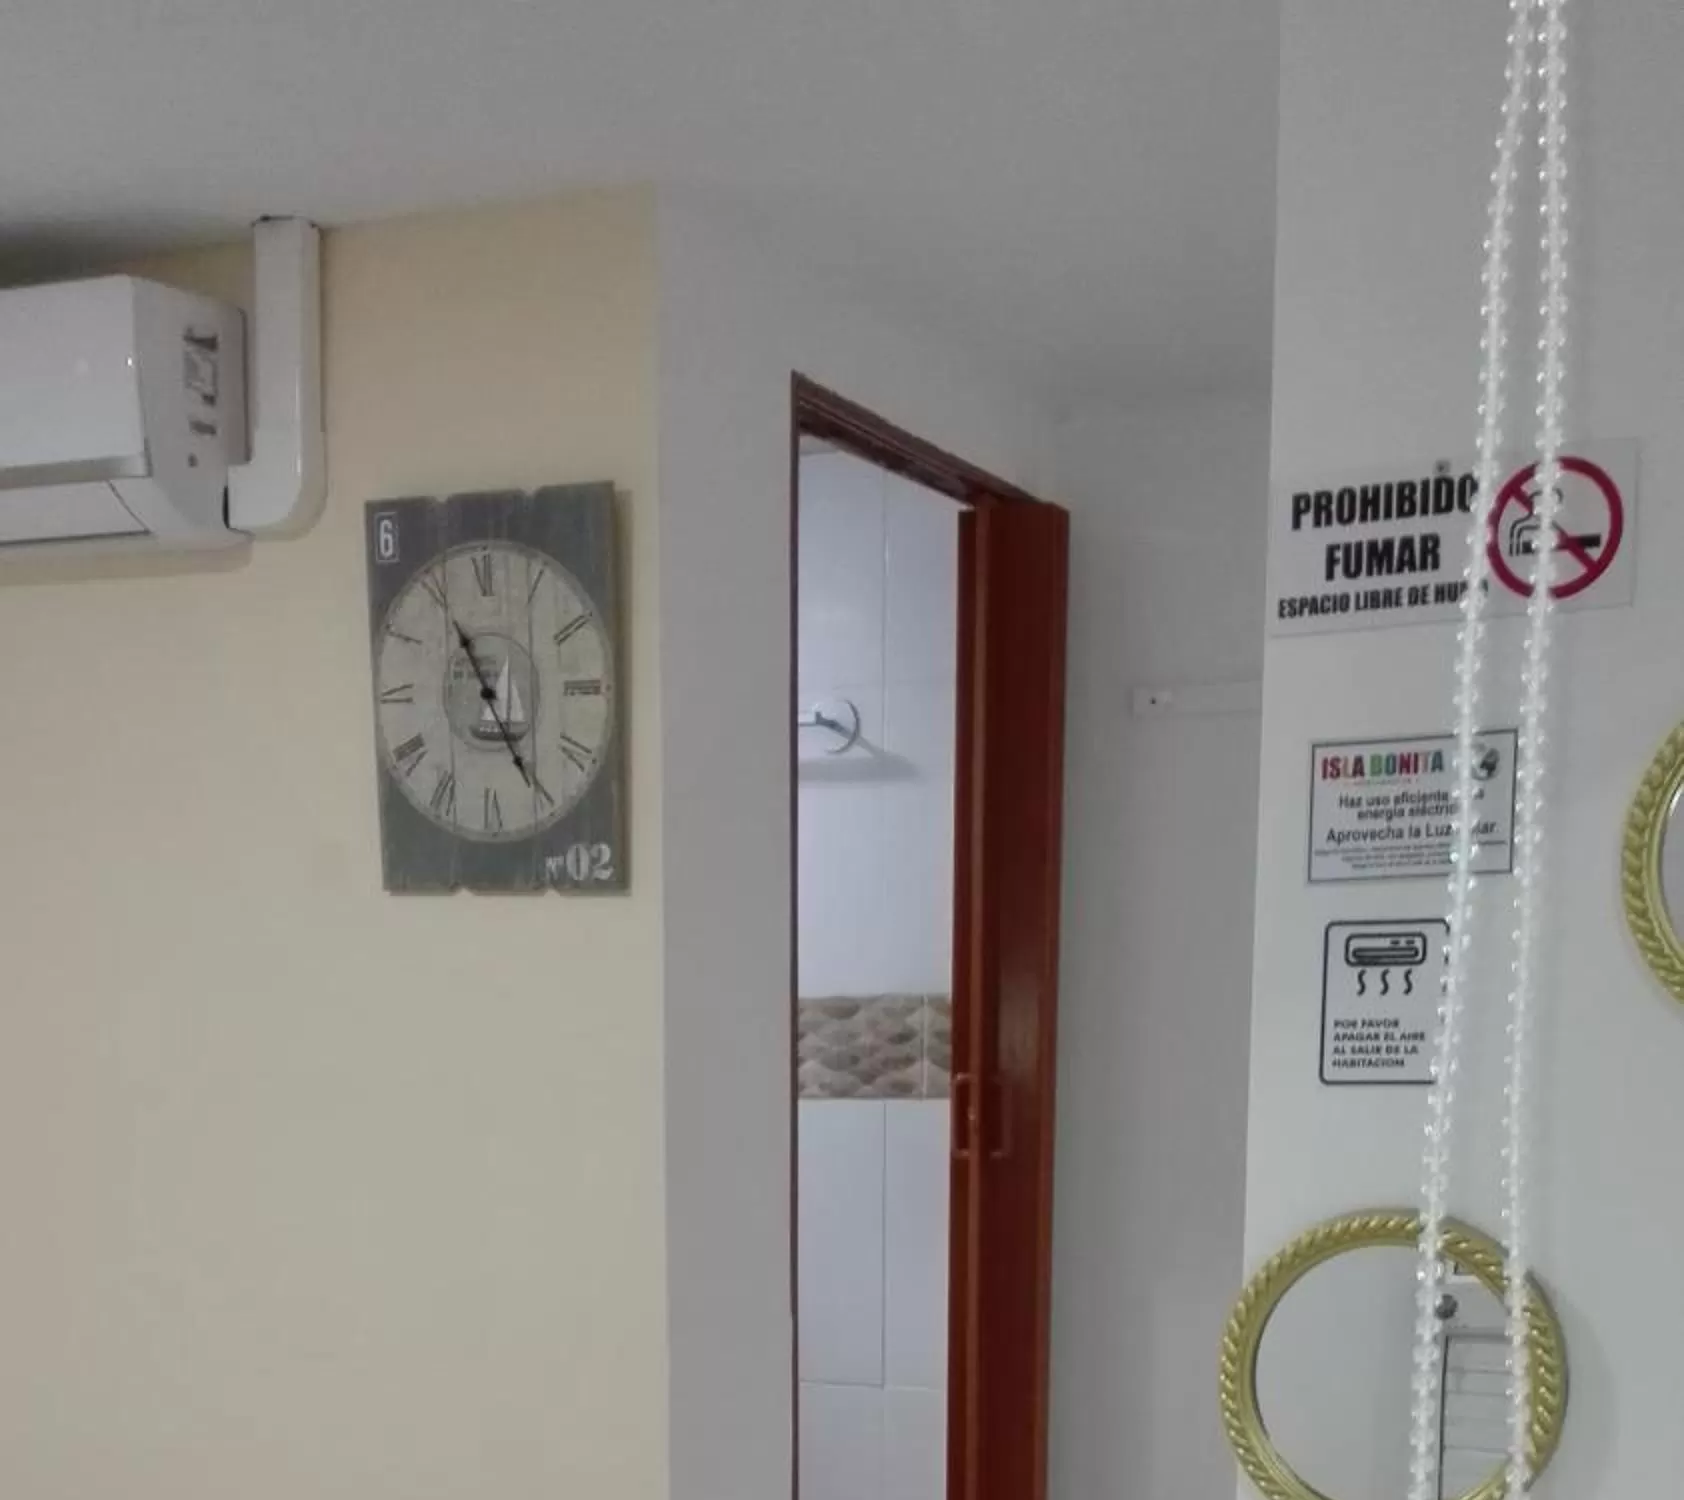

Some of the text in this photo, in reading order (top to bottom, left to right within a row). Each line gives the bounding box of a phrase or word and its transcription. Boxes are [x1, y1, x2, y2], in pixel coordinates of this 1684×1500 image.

[1291, 473, 1479, 531] PROHIBIDO
[379, 518, 394, 558] 6
[1325, 532, 1441, 582] FUMAR
[1278, 579, 1488, 619] ESPACIO LIBRE DE HU
[1321, 751, 1444, 780] ISLA BONITA
[1338, 792, 1363, 809] Haz
[1366, 795, 1390, 807] uso
[1326, 822, 1405, 845] Aprovecha
[1408, 822, 1422, 838] la
